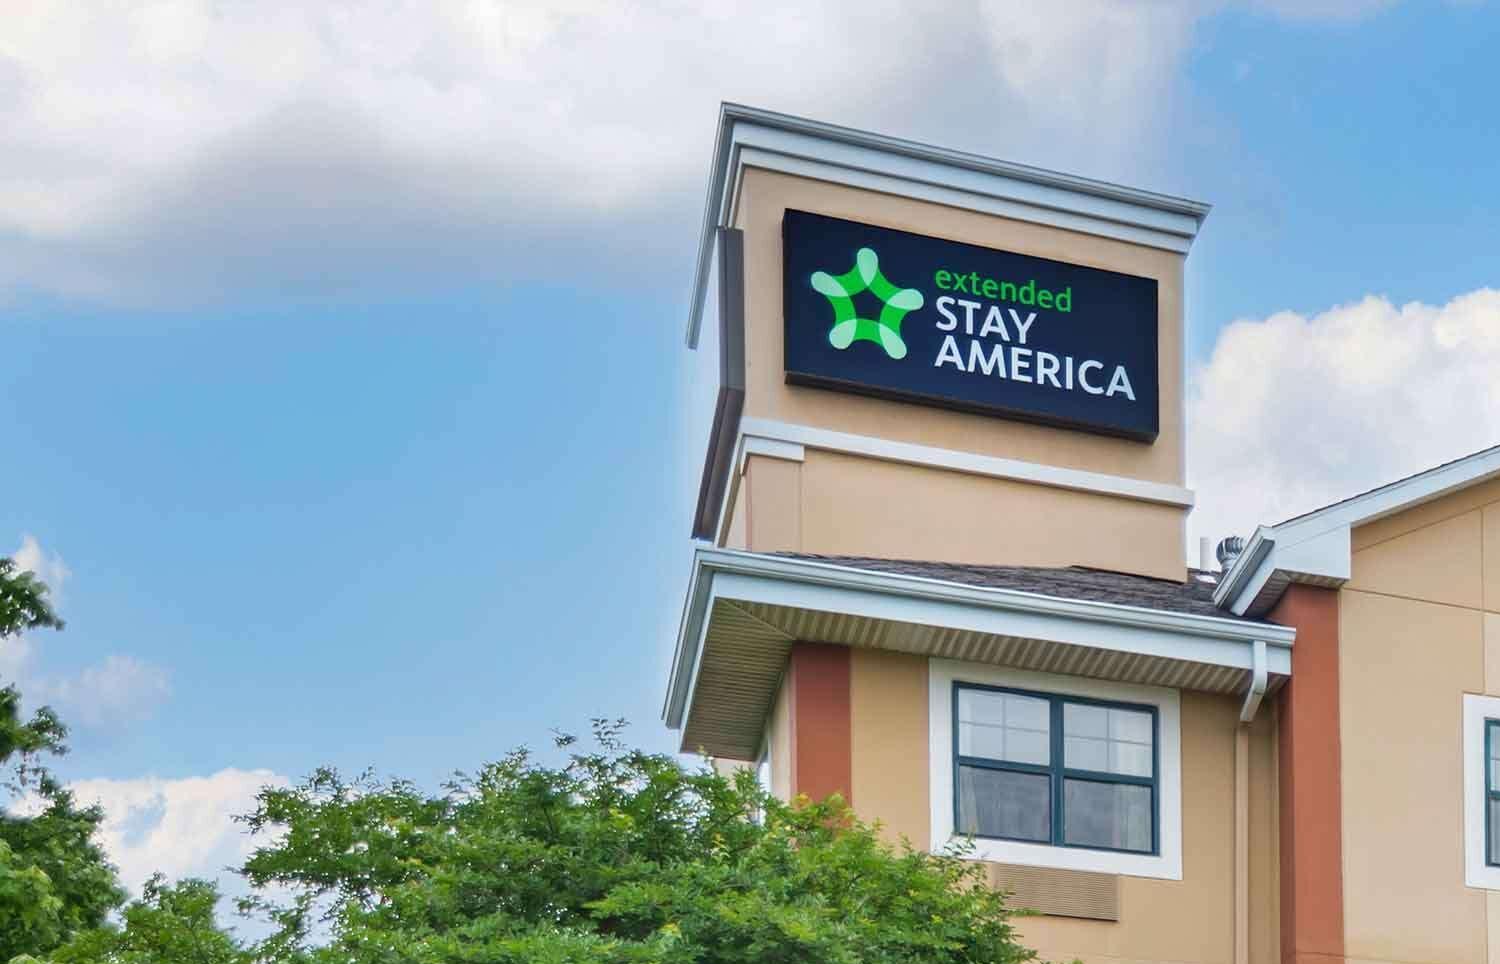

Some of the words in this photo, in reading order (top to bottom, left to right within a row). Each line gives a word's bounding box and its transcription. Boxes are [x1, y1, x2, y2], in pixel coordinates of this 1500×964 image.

[934, 269, 1072, 313] extended
[935, 295, 1038, 345] STAY
[934, 335, 1136, 401] AMERICA
